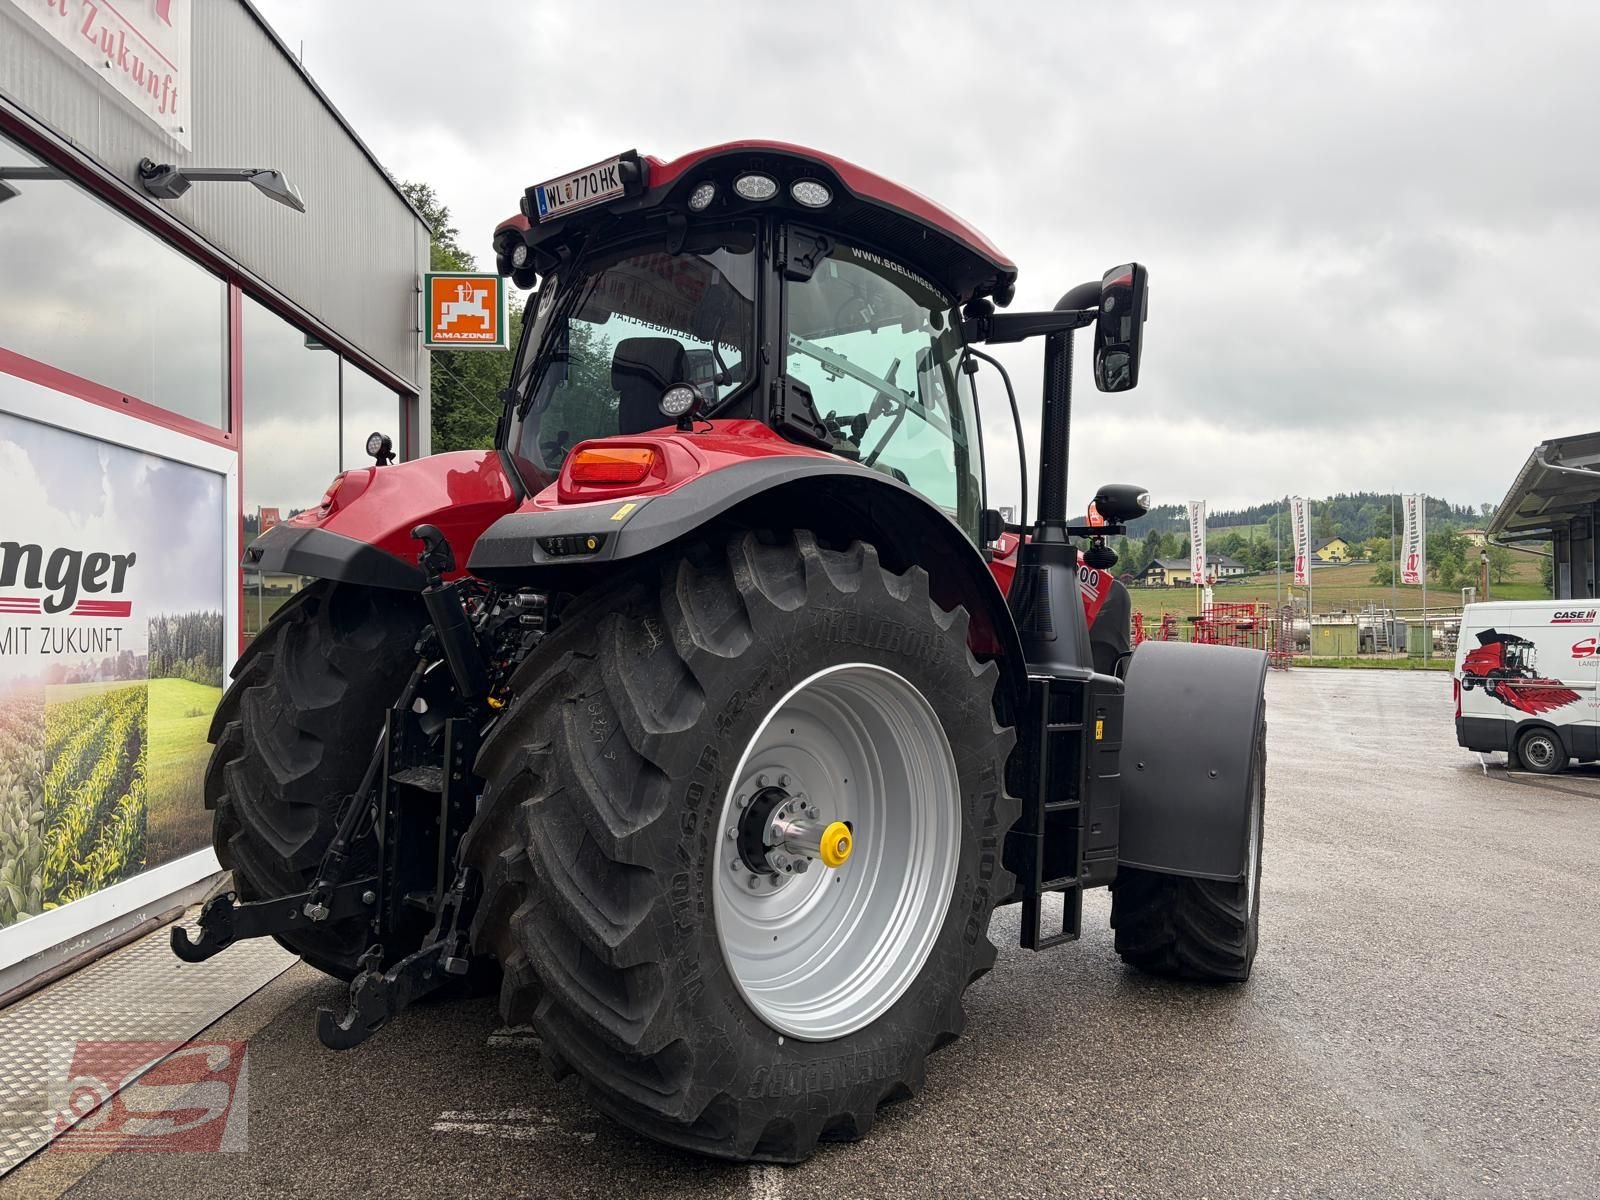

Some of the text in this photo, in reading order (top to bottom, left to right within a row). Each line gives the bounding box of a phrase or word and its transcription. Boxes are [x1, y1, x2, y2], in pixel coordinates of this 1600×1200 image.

[80, 0, 178, 114] Zukunft
[546, 185, 565, 209] WL
[1553, 611, 1585, 619] CASE
[40, 627, 122, 654] ZUKUNFT
